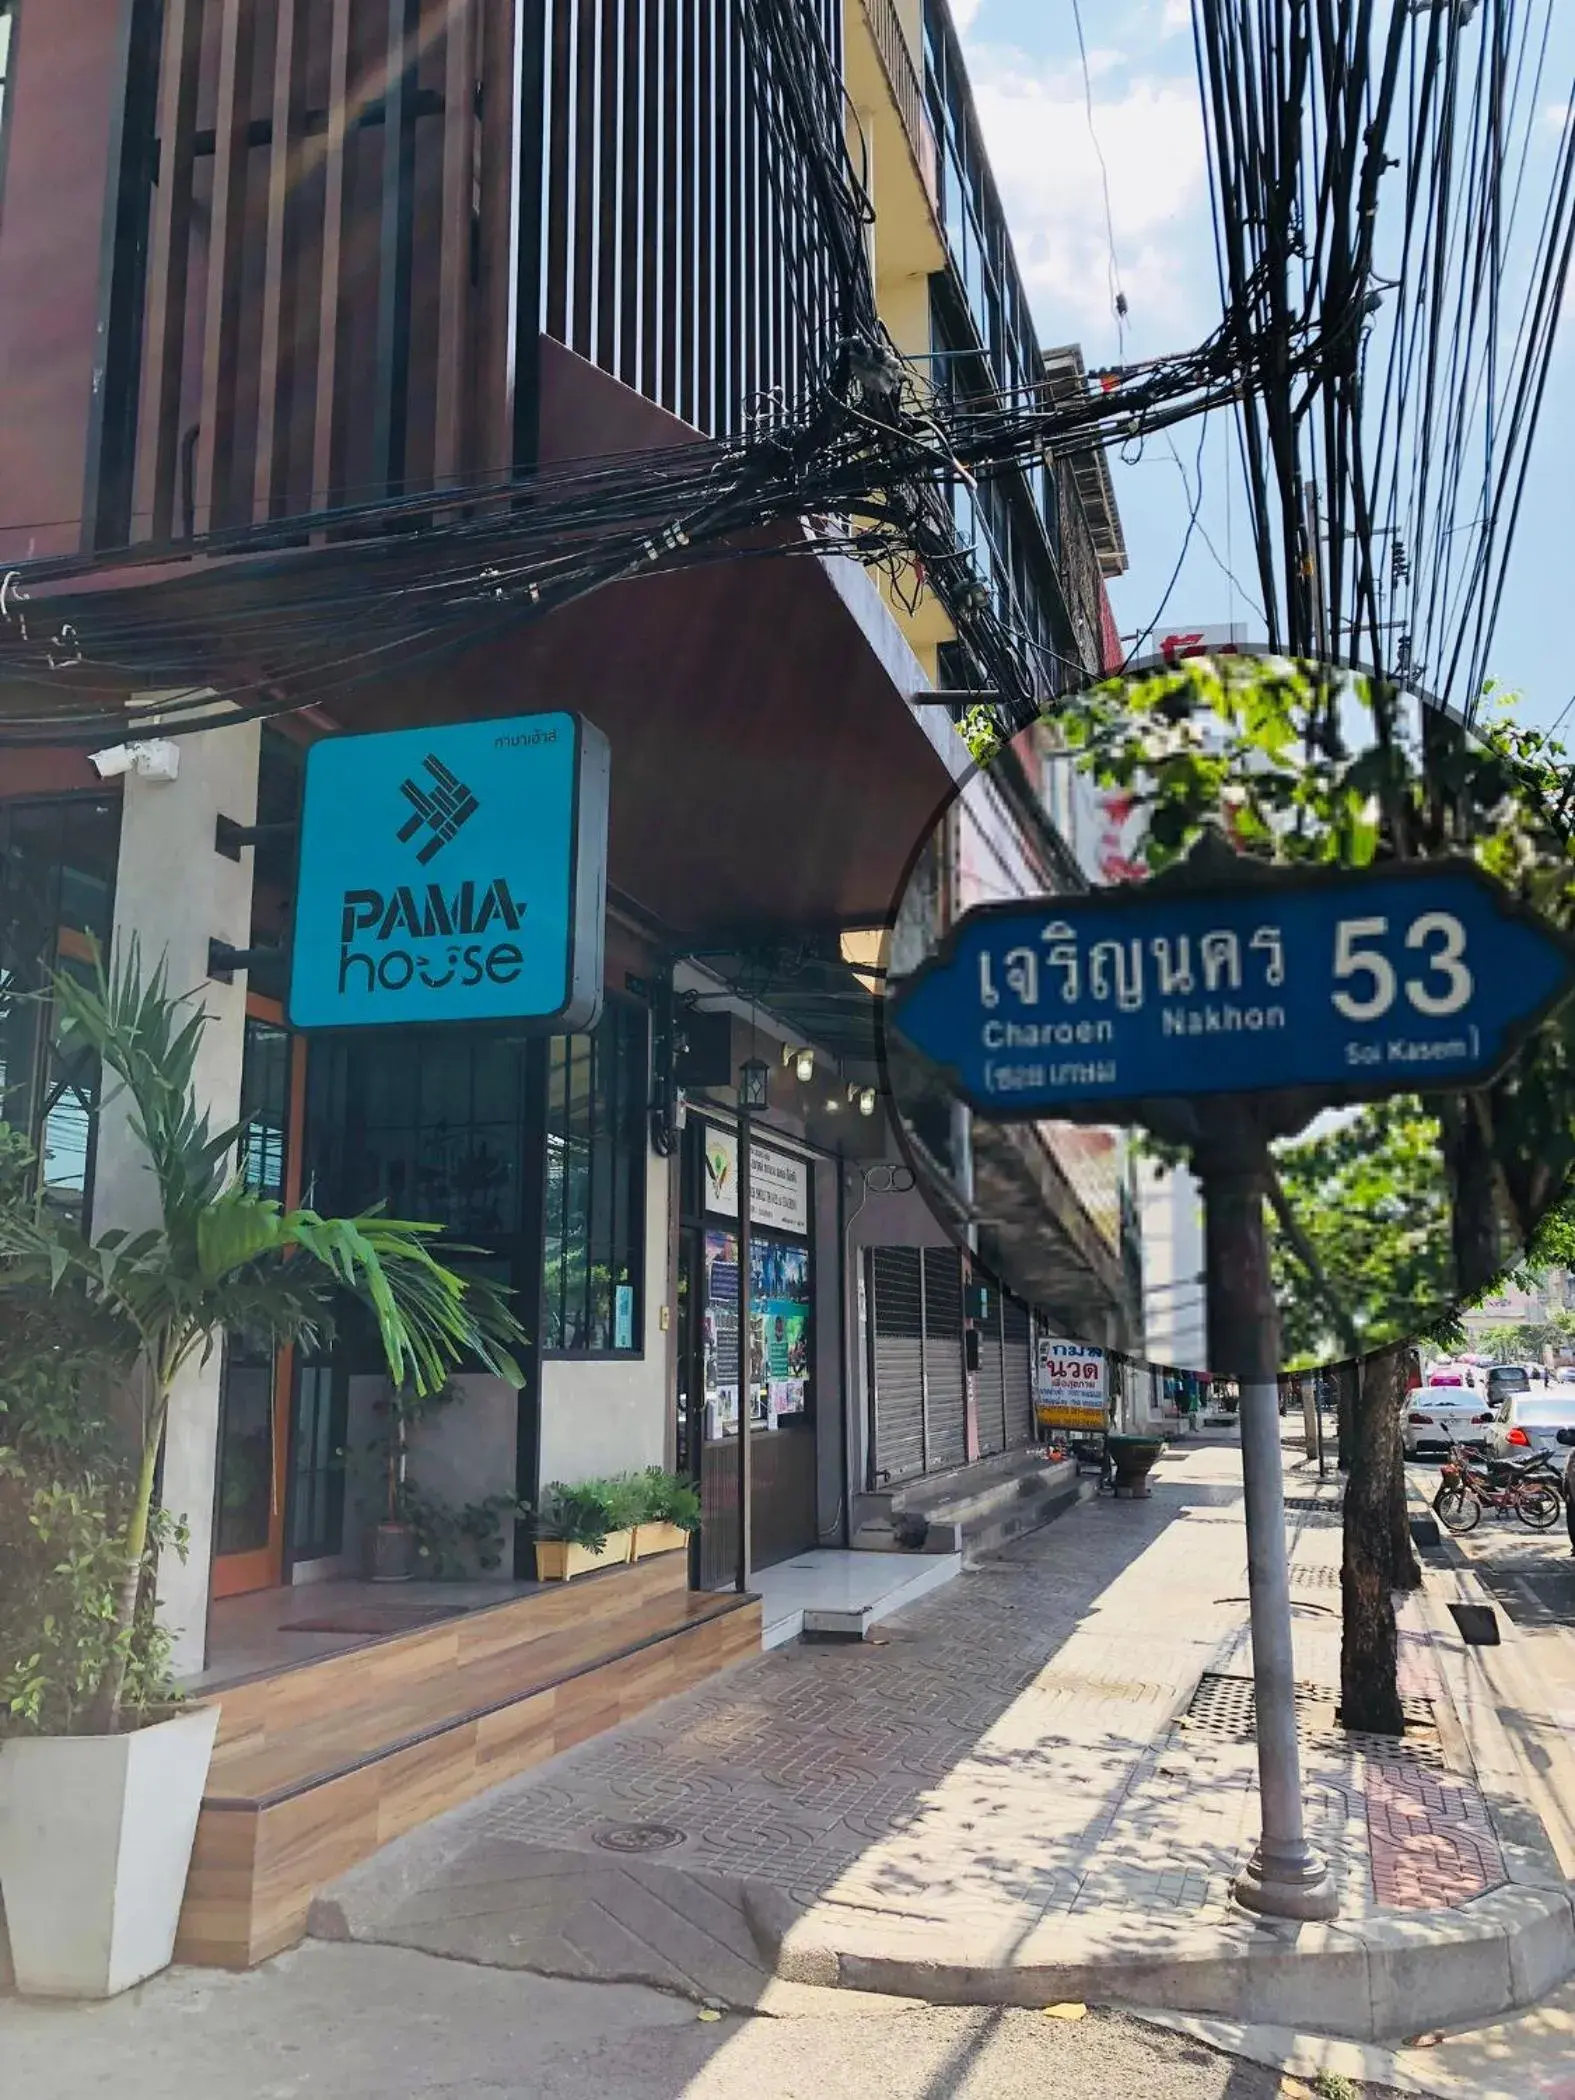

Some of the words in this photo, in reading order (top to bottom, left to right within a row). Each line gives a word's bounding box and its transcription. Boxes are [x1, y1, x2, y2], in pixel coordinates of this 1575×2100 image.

[341, 878, 527, 943] PAMA
[338, 942, 524, 994] house
[979, 921, 1286, 1010] เจริญนคร
[1331, 912, 1475, 1021] 53
[982, 1020, 1113, 1049] Charoen
[1162, 1005, 1286, 1036] Nakhon
[1345, 1041, 1381, 1065] Soi
[1047, 1360, 1098, 1379] นวด
